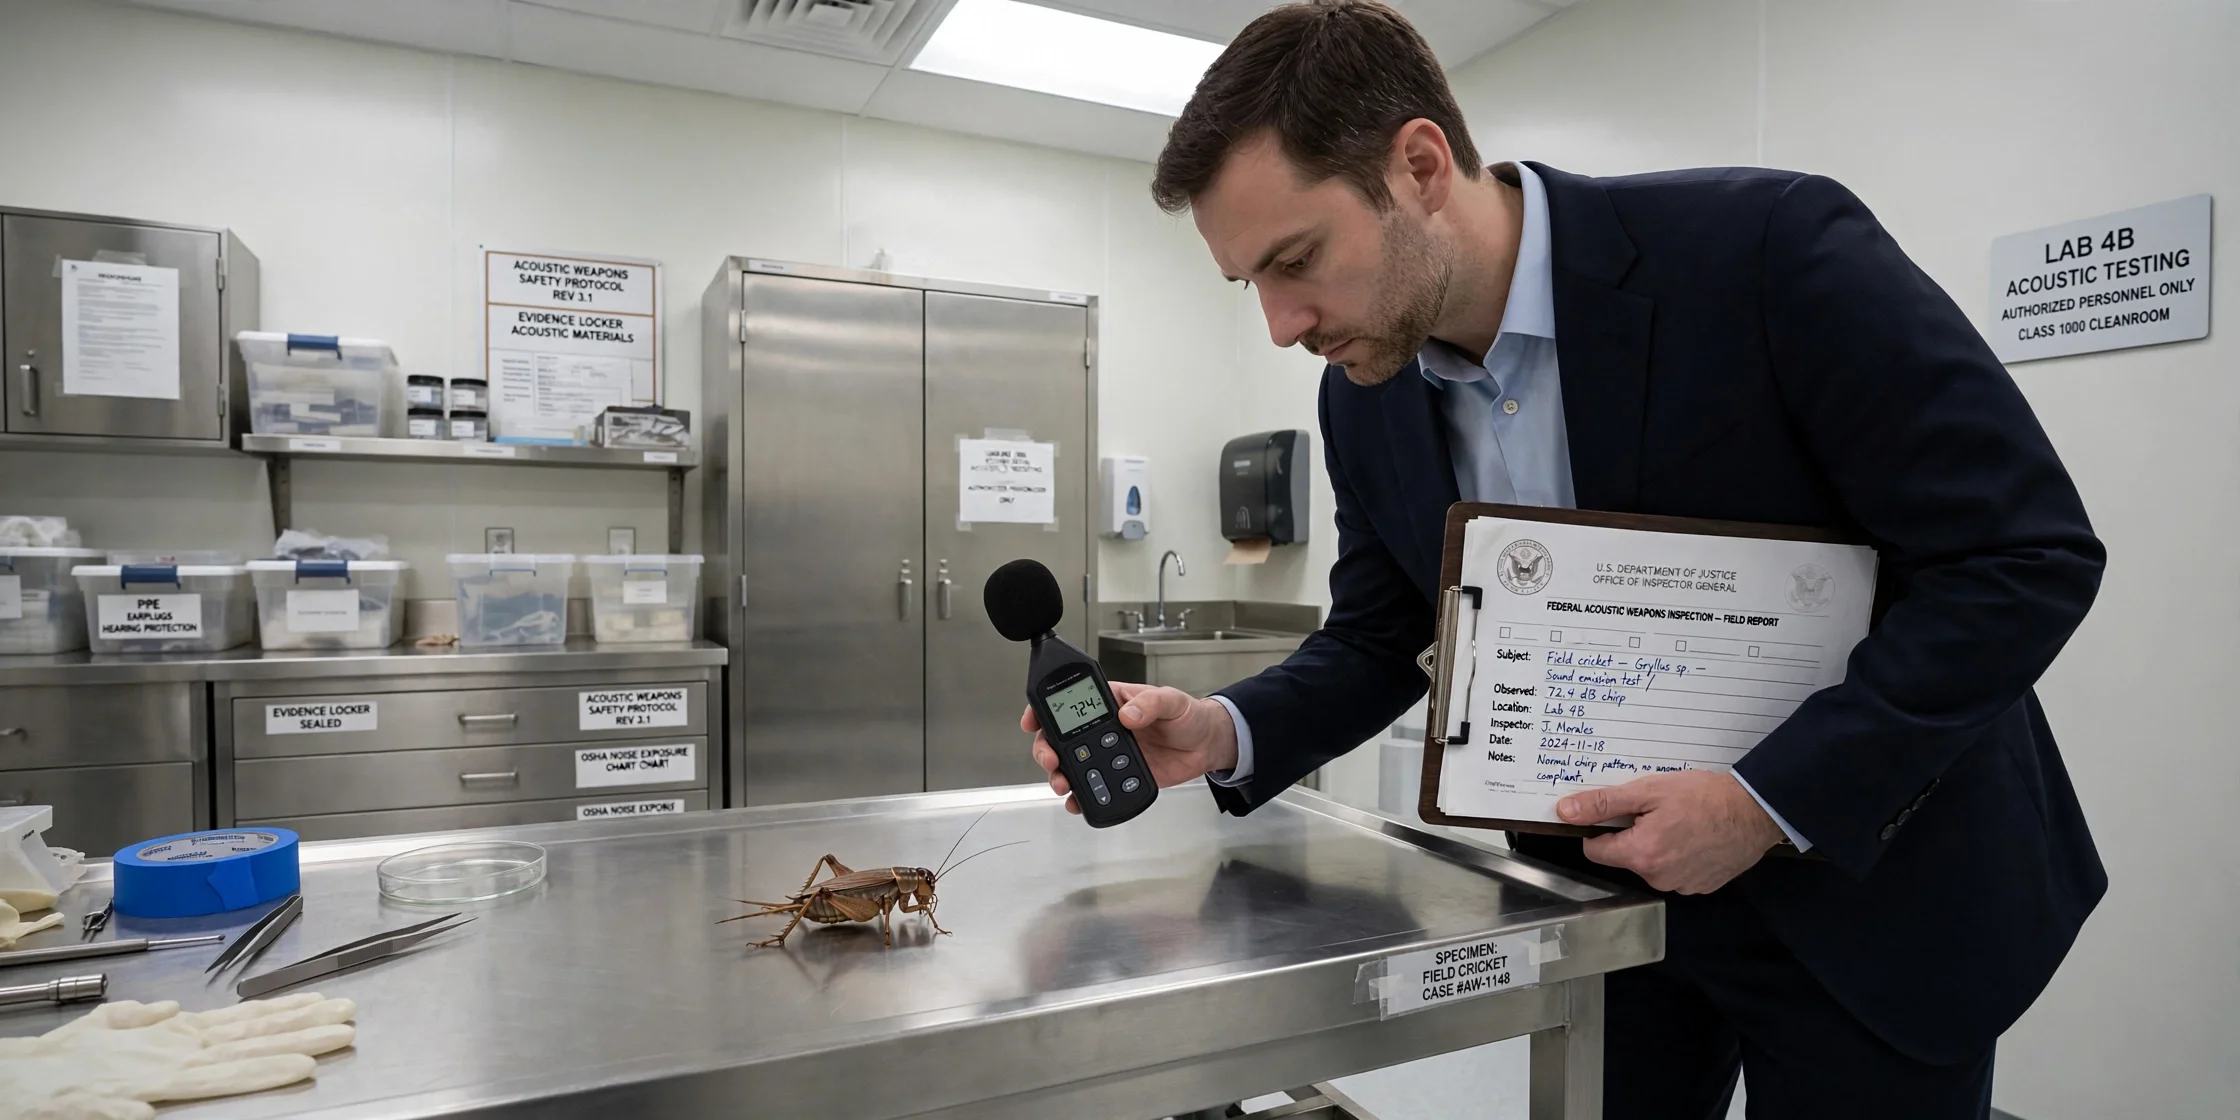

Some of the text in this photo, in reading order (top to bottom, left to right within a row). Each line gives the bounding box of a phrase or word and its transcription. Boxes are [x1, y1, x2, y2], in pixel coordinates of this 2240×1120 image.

[2045, 227, 2135, 264] LAB 4B
[514, 261, 628, 279] ACOUSTIC WEAPONS
[2006, 248, 2190, 297] ACOUSTIC TESTING
[519, 274, 624, 291] SAFETY PROTOCOL
[553, 290, 575, 301] REV
[2001, 278, 2195, 321] AUTHORIZED PERSONNEL ONLY
[519, 312, 623, 328] EVIDENCE LOCKER
[2018, 307, 2170, 341] CLASS 1000 CLEANROOM
[511, 326, 634, 342] ACOUSTIC MATERIALS
[1596, 563, 1736, 580] U.S. DEPARTMENT OF JUSTICE
[1593, 575, 1736, 593] OFFICE OF INSPECTOR GENERAL
[138, 599, 160, 609] PPE
[127, 612, 172, 621] EARPLUGS
[1547, 602, 1582, 613] FEDERAL
[1585, 604, 1624, 616] ACOUSTIC
[1627, 607, 1666, 619] WEAPONS
[1667, 609, 1713, 621] INSPECTION
[1724, 615, 1745, 624] FIELD
[1747, 616, 1779, 627] REPORT
[102, 624, 197, 633] HEARING PROTECTION
[1497, 649, 1531, 662] Subject:
[1547, 651, 1573, 665] Field
[1578, 654, 1613, 666] cricket
[1635, 658, 1669, 676] Gryllus
[1676, 665, 1689, 677] sp.
[1546, 669, 1575, 681] Sound
[1579, 672, 1616, 684] emission
[1621, 672, 1641, 685] test
[1494, 684, 1537, 696] Observed:
[587, 691, 682, 703] ACOUSTIC WEAPONS
[1580, 687, 1596, 700] dB
[1602, 689, 1626, 707] chirp
[273, 704, 370, 717] EVIDENCE LOCKER
[589, 703, 677, 714] SAFETY PROTOCOL
[1492, 700, 1532, 713] Location:
[1544, 703, 1563, 714] Lab
[300, 719, 341, 728] SEALED
[616, 716, 634, 725] REV
[1491, 718, 1534, 731] Inspector:
[1541, 721, 1593, 734] J. Morales
[1489, 734, 1513, 745] Date:
[1540, 738, 1605, 751] 2024-11-18
[581, 747, 688, 761] OSHA NOISE EXPOSURE
[1488, 751, 1515, 762] Notes:
[606, 759, 669, 771] CHART CHART
[1537, 754, 1571, 766] Normal
[1575, 756, 1597, 772] chirp
[1602, 759, 1638, 773] pattern,
[1537, 768, 1583, 787] compliant.
[583, 807, 608, 817] OSHA
[611, 805, 635, 814] NOISE
[1435, 942, 1498, 965] SPECIMEN:
[1423, 956, 1508, 984] FIELD CRICKET
[1423, 972, 1510, 1001] CASE #AW-1148
